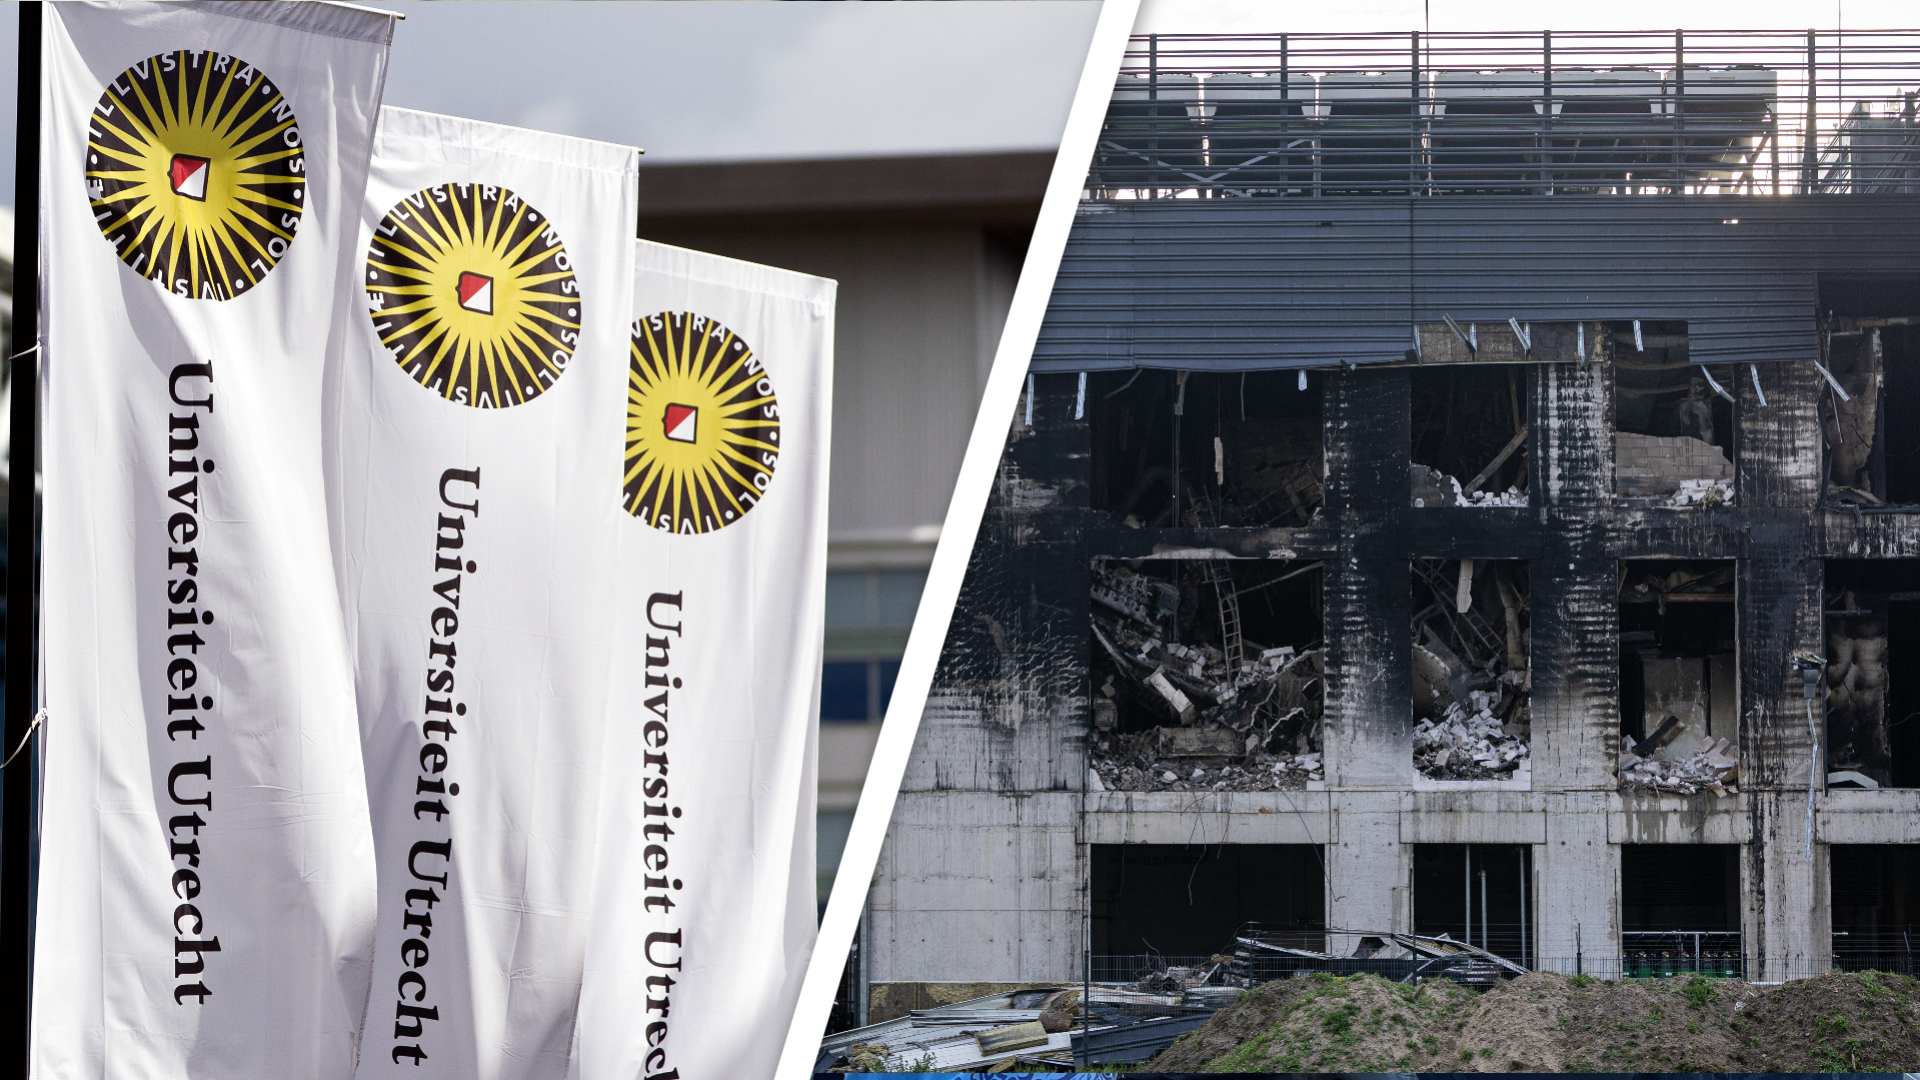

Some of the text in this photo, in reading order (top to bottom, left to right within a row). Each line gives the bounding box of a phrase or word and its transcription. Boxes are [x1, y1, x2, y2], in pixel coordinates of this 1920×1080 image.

[89, 49, 253, 138] ILLVSTRA
[271, 102, 305, 173] NOS
[250, 213, 300, 276] SOL
[368, 183, 523, 258] ILLVSTRA
[541, 225, 579, 294] NOS
[538, 329, 578, 385] SOL
[744, 354, 780, 419] NOS
[738, 452, 778, 506] SOL
[166, 359, 222, 1006] Universiteit Utrecht
[391, 466, 481, 1067] Universiteit Utrecht
[643, 590, 683, 914] Universiteit
